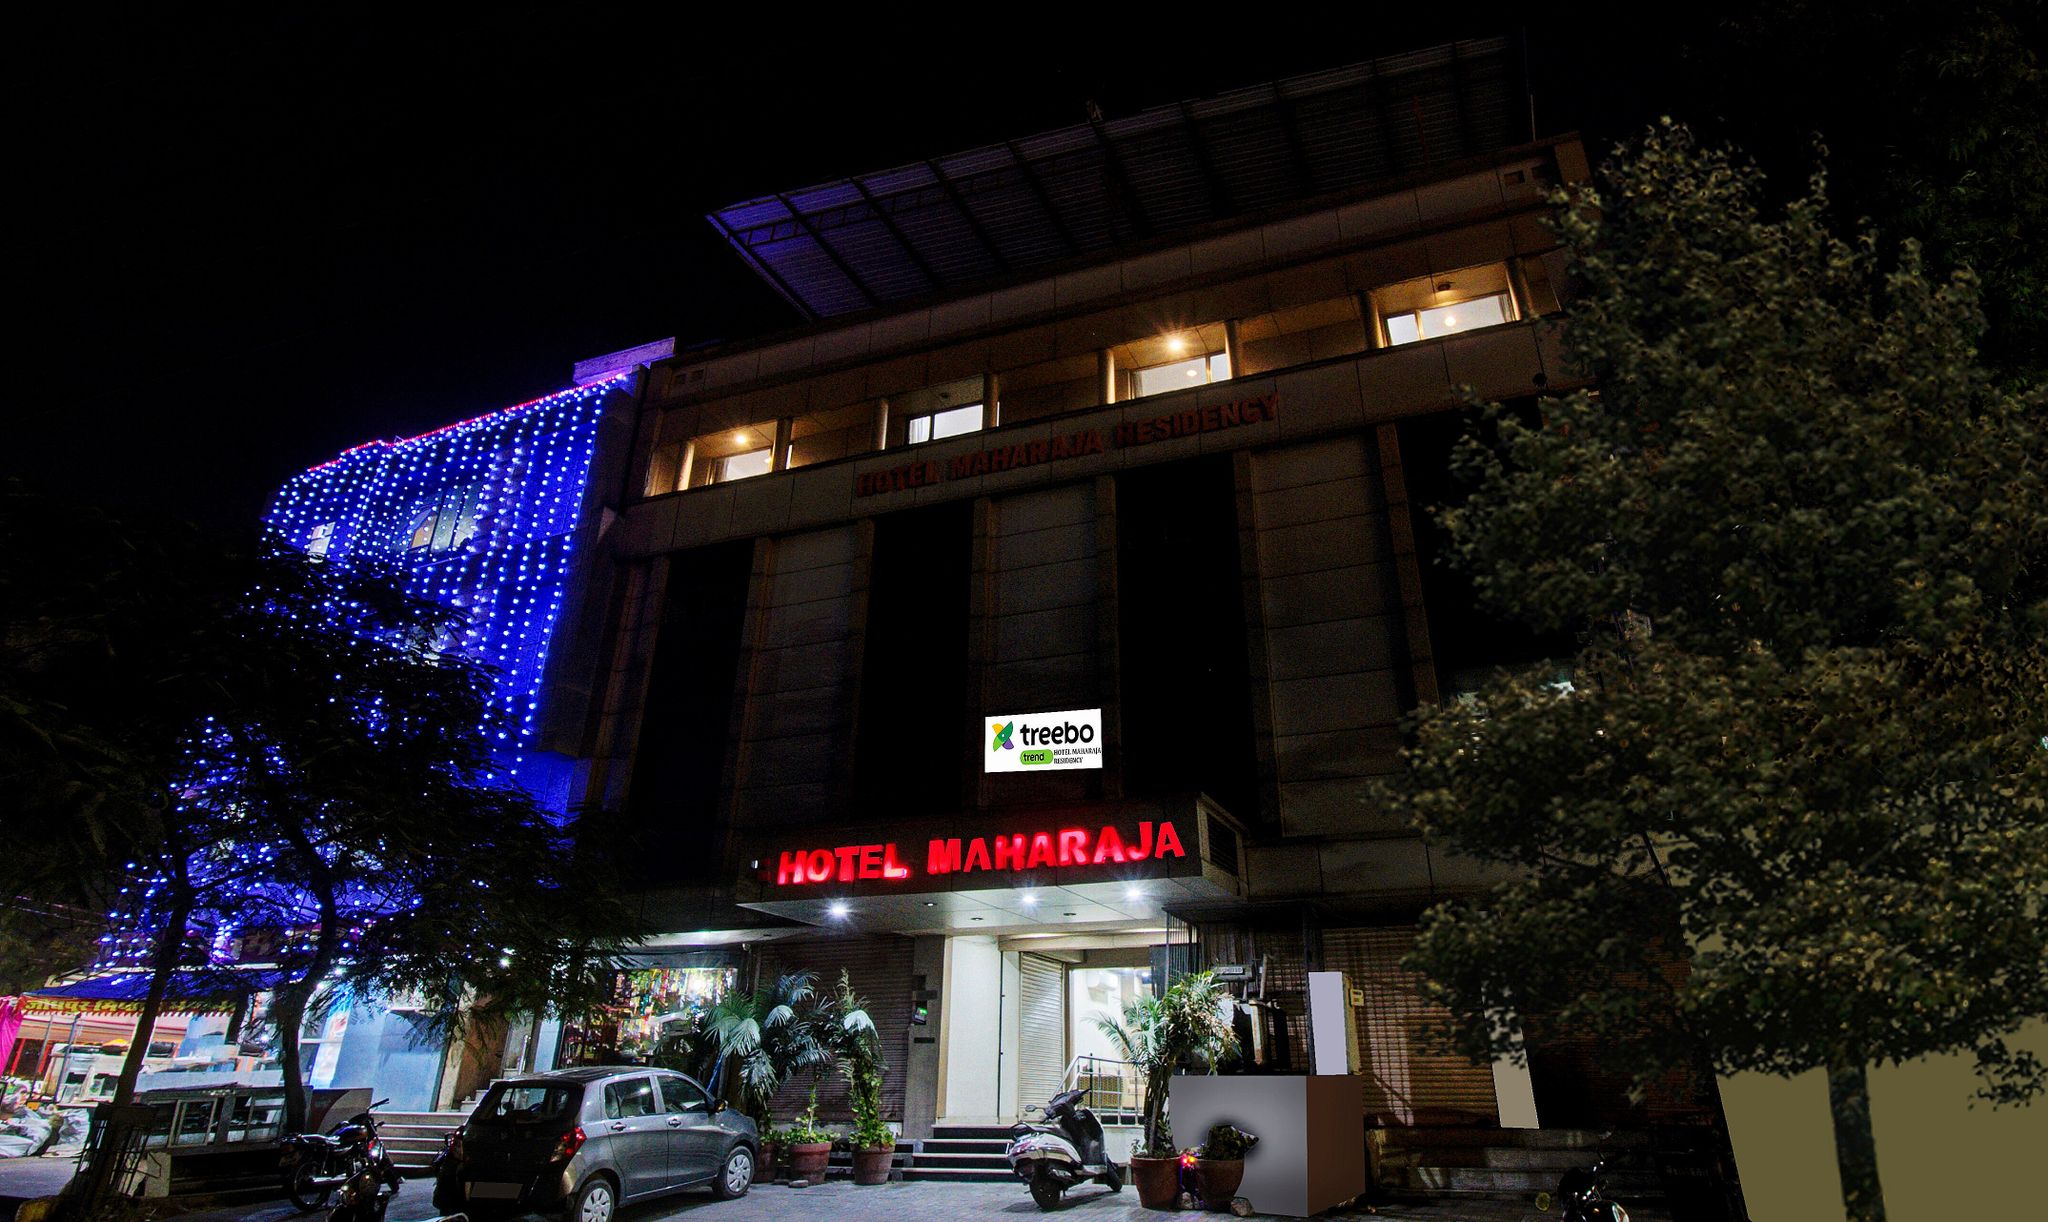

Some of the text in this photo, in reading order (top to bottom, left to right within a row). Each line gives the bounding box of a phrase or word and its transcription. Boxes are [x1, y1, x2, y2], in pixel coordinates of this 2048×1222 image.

[855, 392, 1279, 498] HOTEL MAHARAJA RESIDENCY
[1020, 721, 1094, 746] treebo
[1023, 752, 1045, 762] trend
[1053, 747, 1102, 756] HOTEL MAHARAJA
[777, 821, 1186, 886] HOTEL MAHARAJA
